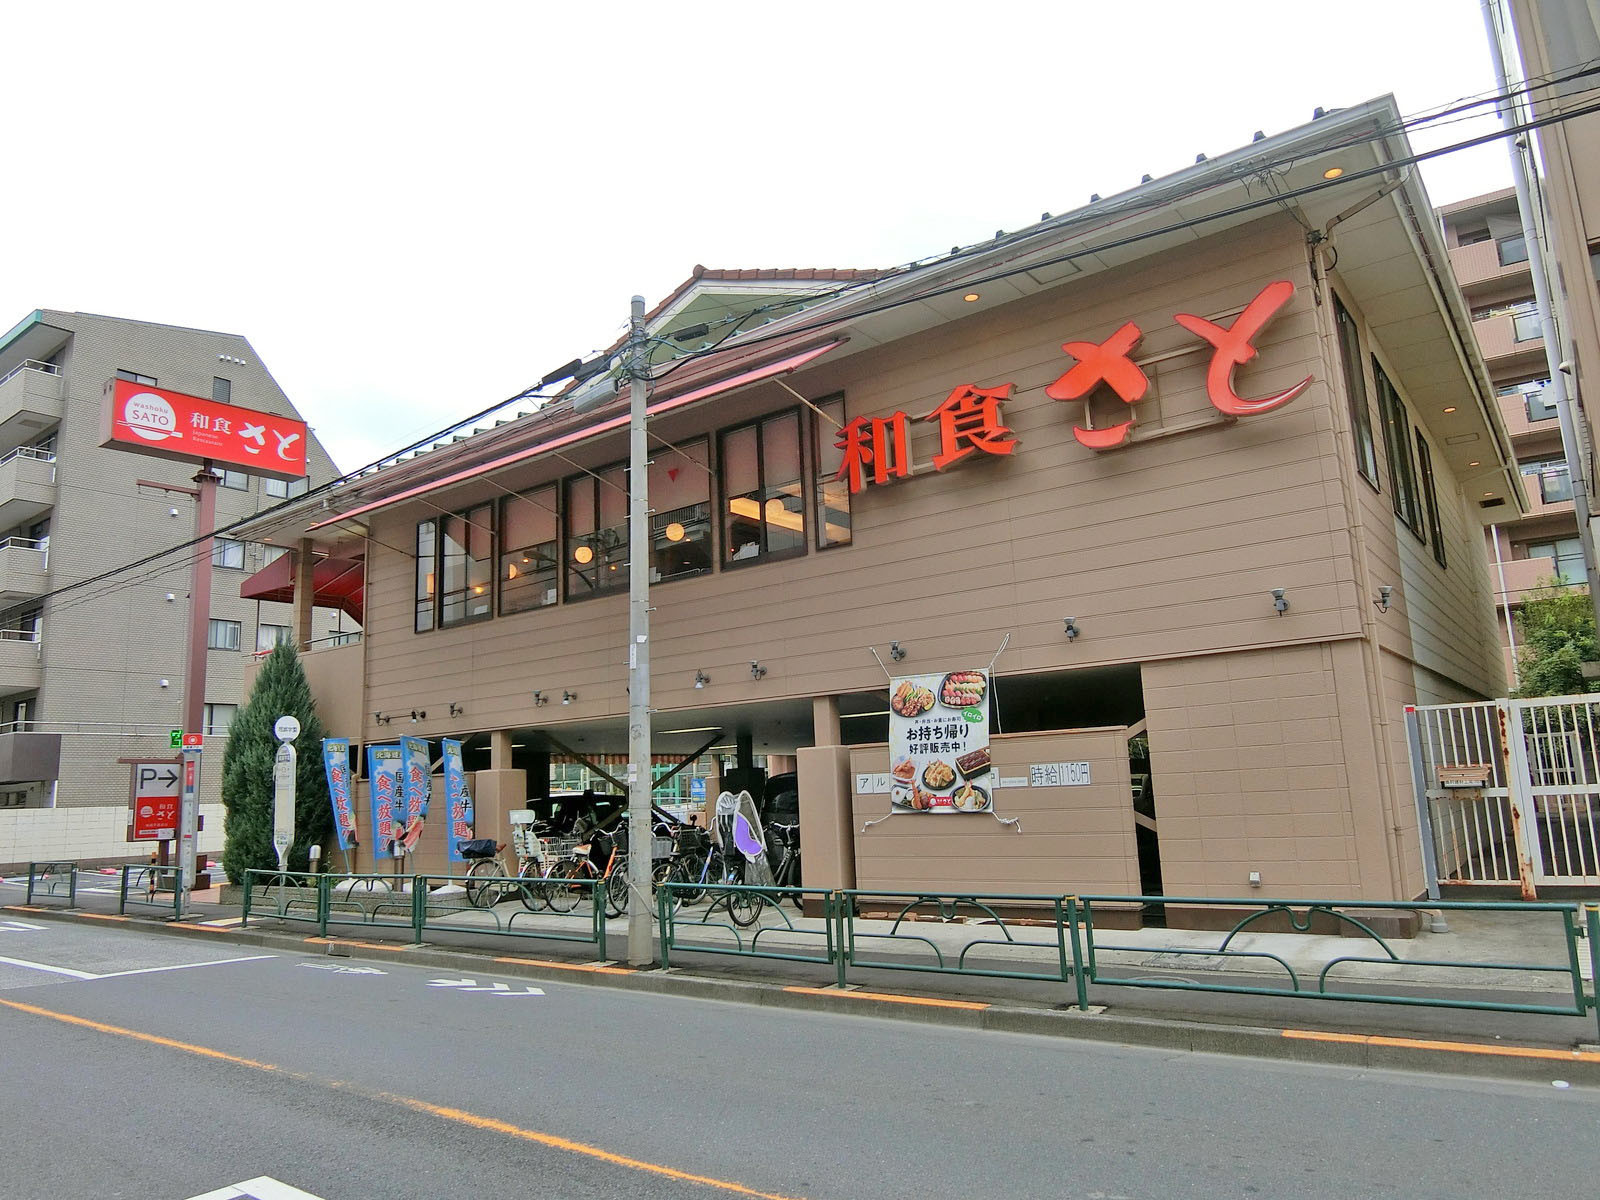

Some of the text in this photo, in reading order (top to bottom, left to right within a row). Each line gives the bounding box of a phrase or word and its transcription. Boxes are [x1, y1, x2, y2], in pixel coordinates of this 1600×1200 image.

[833, 280, 1314, 494] 和食さと
[133, 401, 169, 414] washoku
[132, 410, 169, 426] SATO
[963, 710, 982, 721] イロイロ
[906, 723, 969, 741] お持ち帰り
[376, 750, 402, 759] 北海道
[909, 741, 967, 755] 好評販売中!
[140, 768, 157, 789] P
[1031, 763, 1089, 785] 時給1150円
[395, 771, 405, 812] 国産牛
